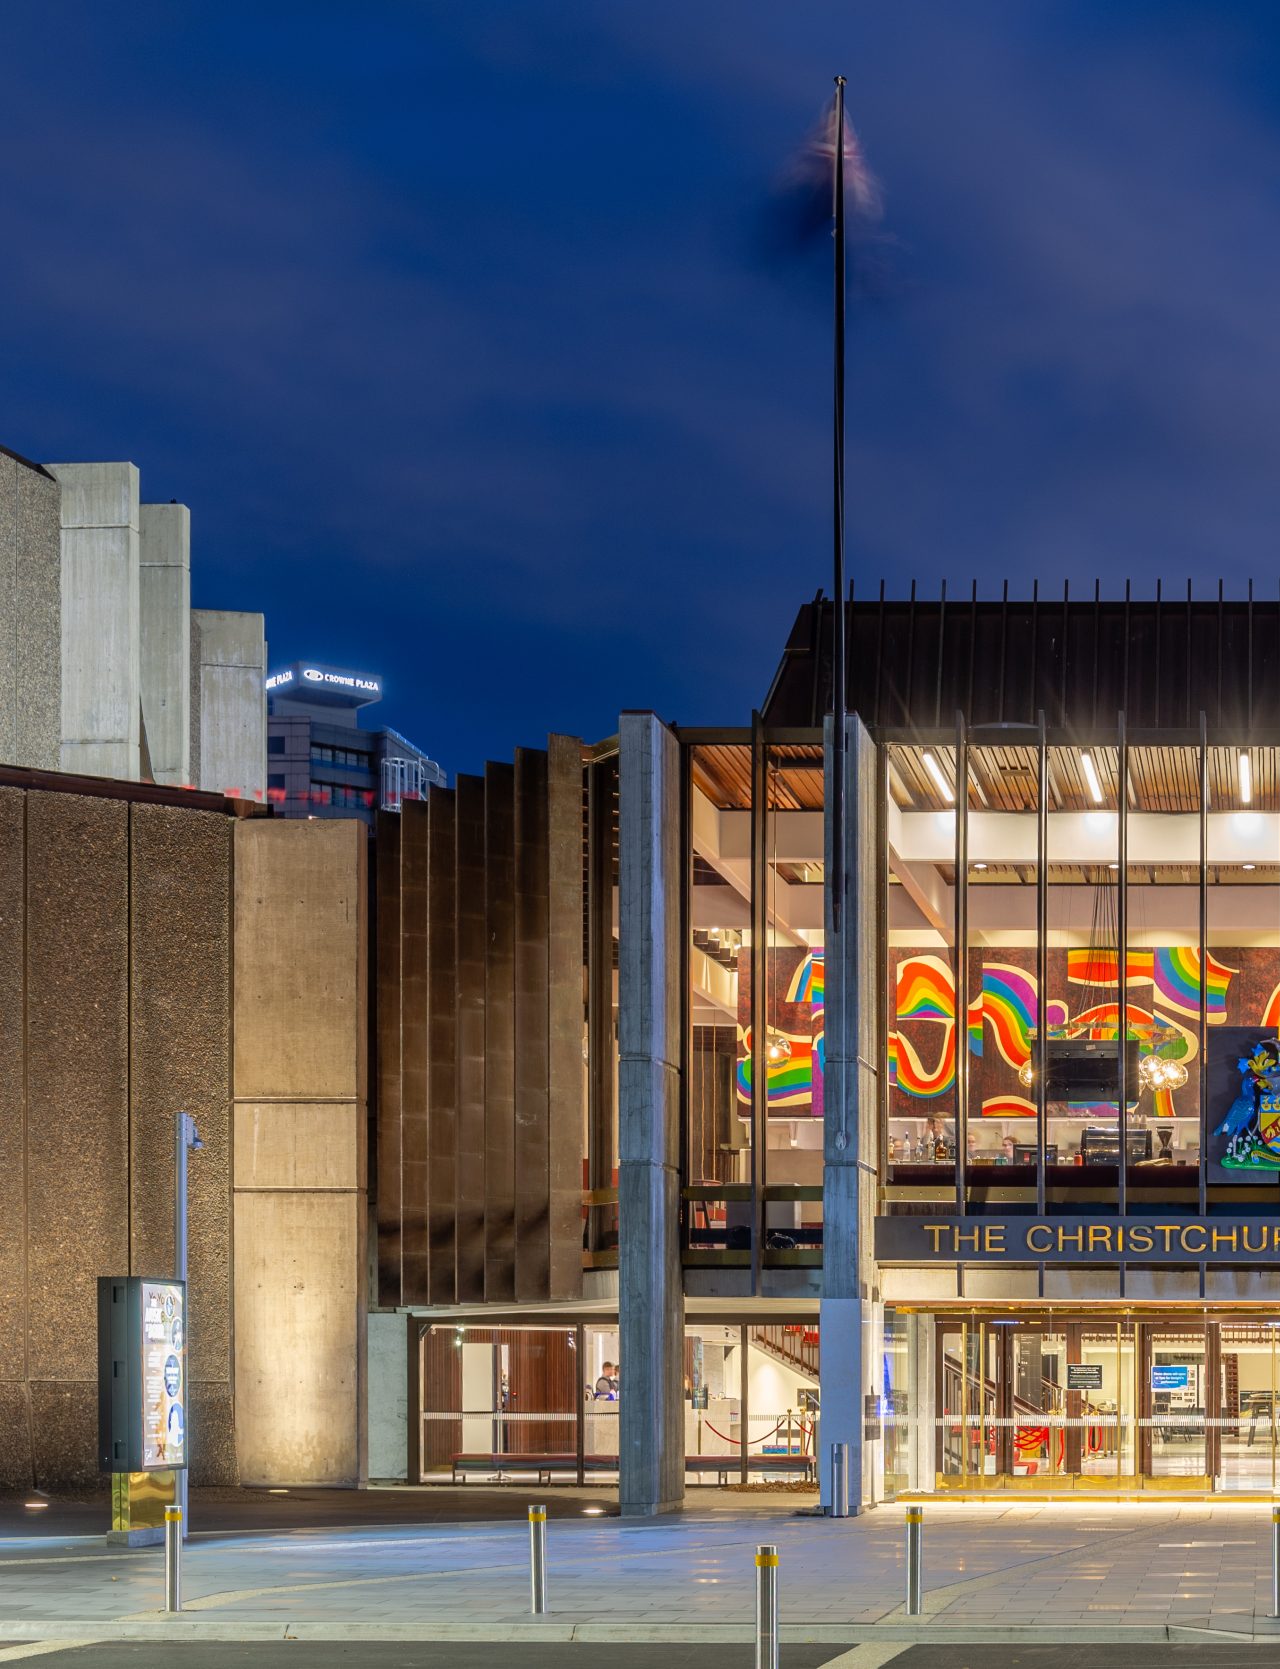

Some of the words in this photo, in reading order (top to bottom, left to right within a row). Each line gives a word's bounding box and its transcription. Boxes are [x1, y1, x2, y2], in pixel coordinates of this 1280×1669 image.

[276, 670, 293, 685] PLAZA
[324, 673, 355, 687] CROWNE
[355, 679, 379, 691] PLAZA
[923, 1225, 1006, 1253] THE
